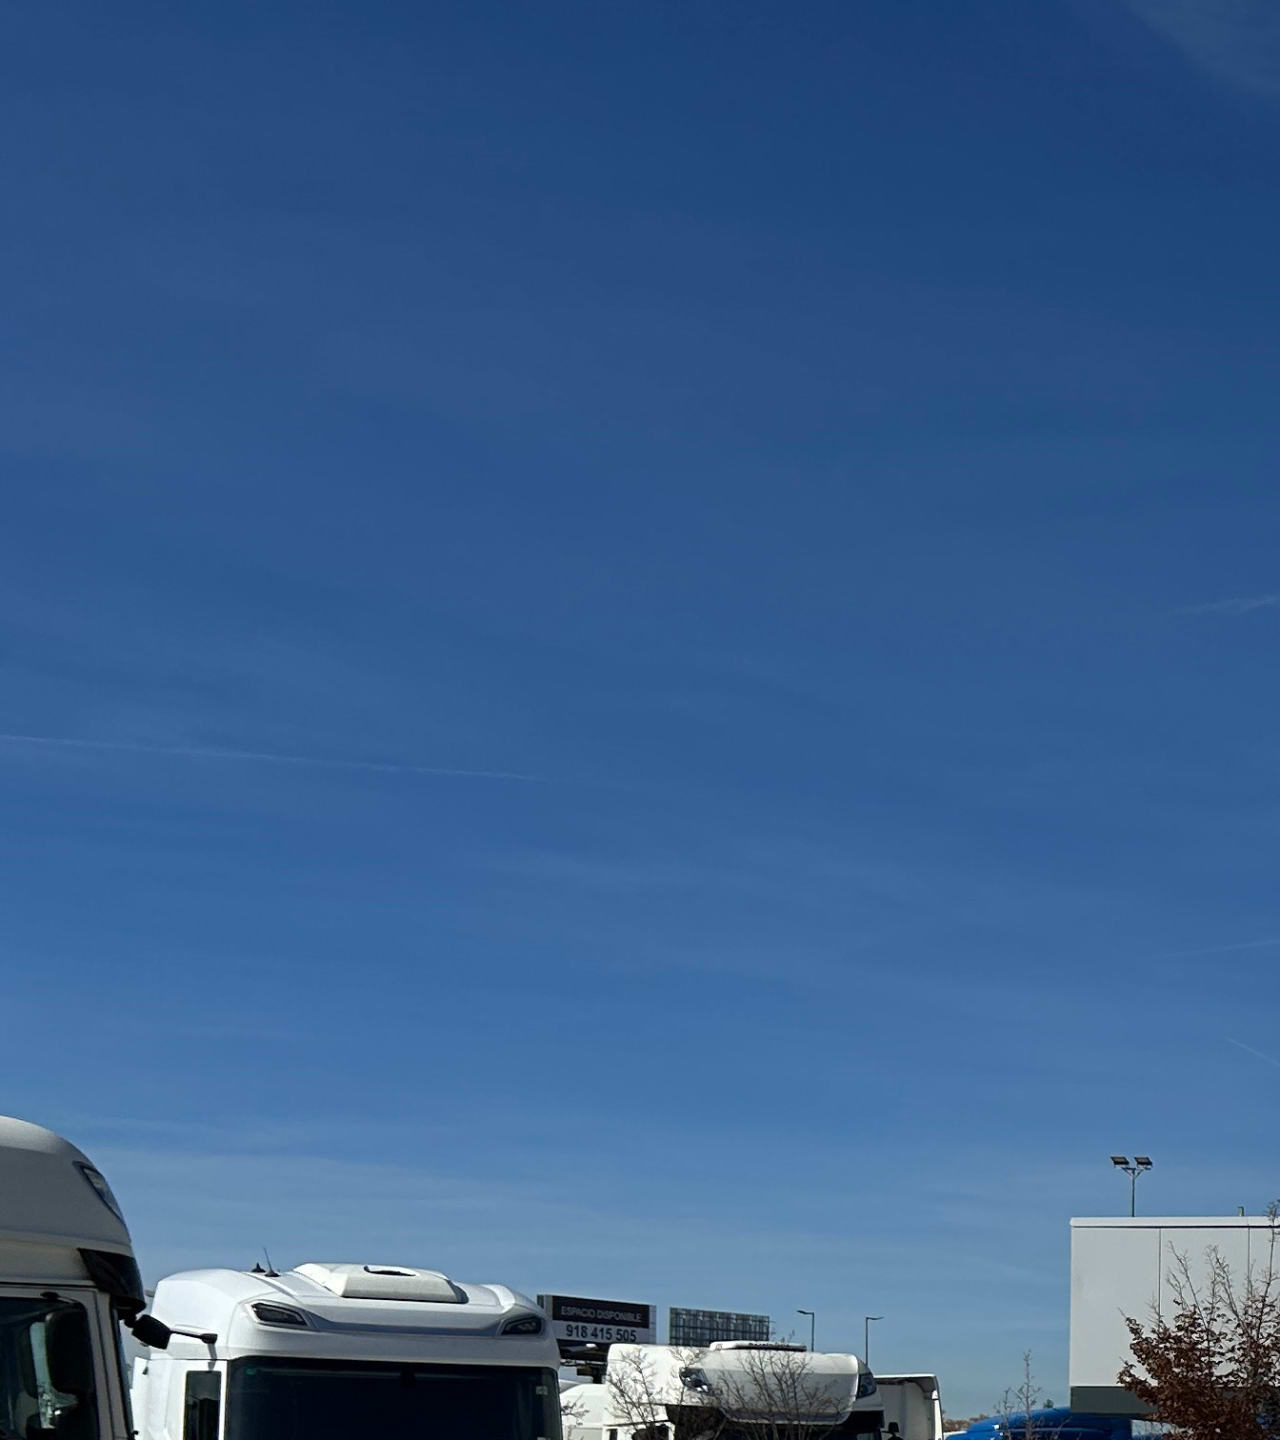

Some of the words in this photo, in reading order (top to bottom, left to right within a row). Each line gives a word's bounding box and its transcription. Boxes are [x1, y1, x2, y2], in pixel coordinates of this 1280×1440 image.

[566, 1324, 588, 1338] 918
[590, 1328, 612, 1341] 415
[616, 1329, 637, 1343] 505
